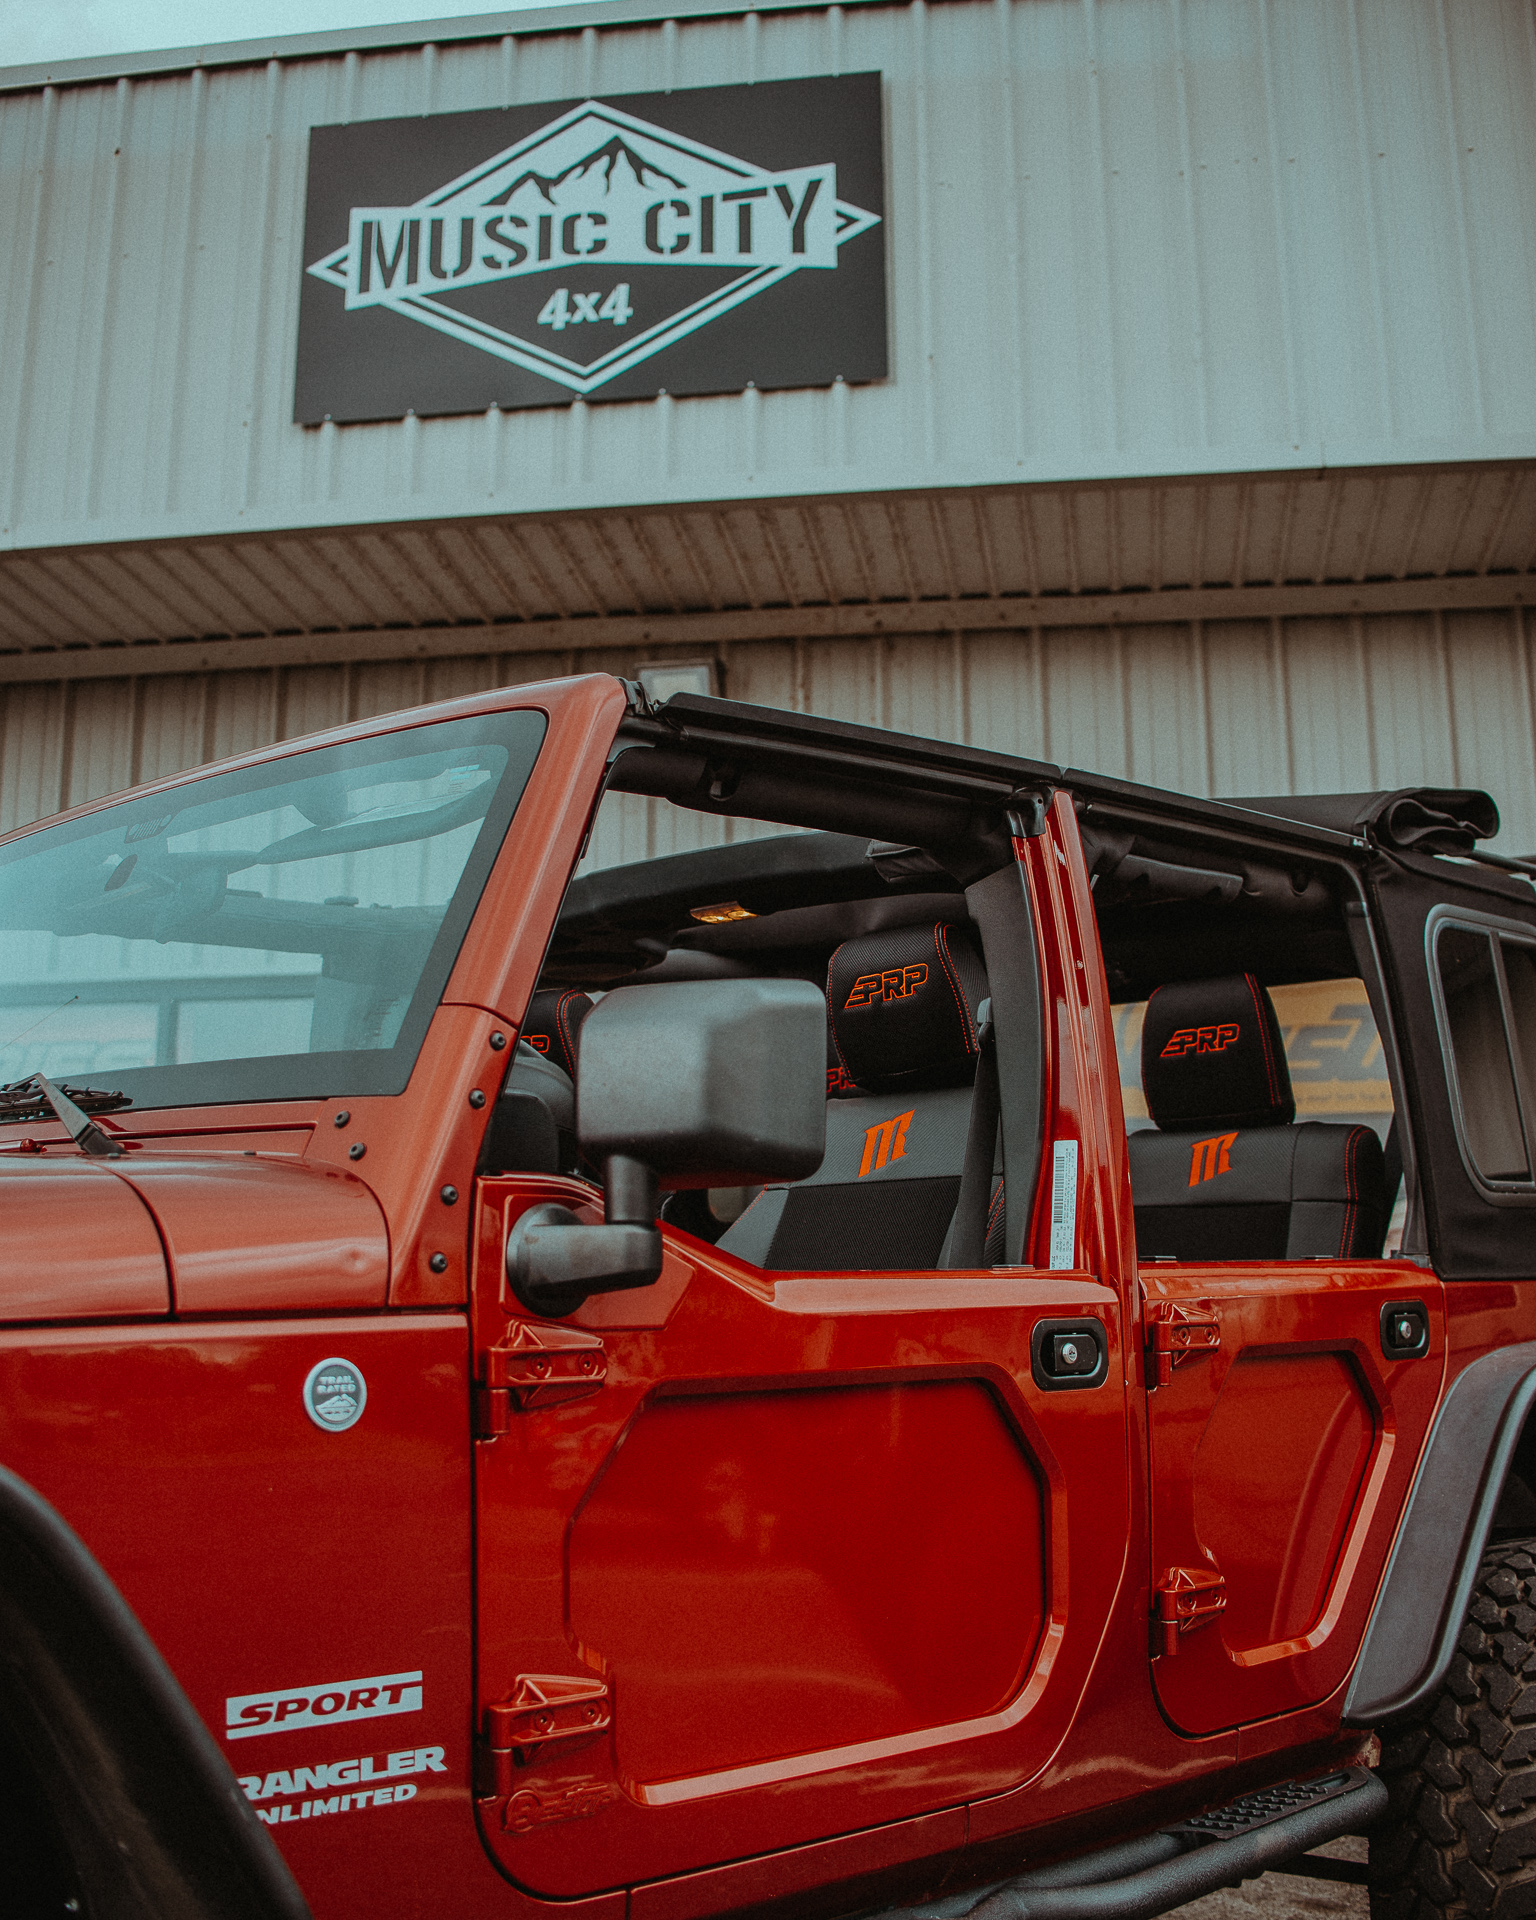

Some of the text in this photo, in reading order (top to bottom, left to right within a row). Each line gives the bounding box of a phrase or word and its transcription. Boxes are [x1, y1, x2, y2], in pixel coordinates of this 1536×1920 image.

[358, 178, 822, 293] MUSIC CITY
[537, 283, 634, 331] 4x4
[844, 963, 929, 1009] PRP
[1159, 1023, 1240, 1058] PRP
[232, 1681, 420, 1727] SPORT
[235, 1746, 448, 1801] RANGLER
[254, 1784, 418, 1825] NLIMITED
